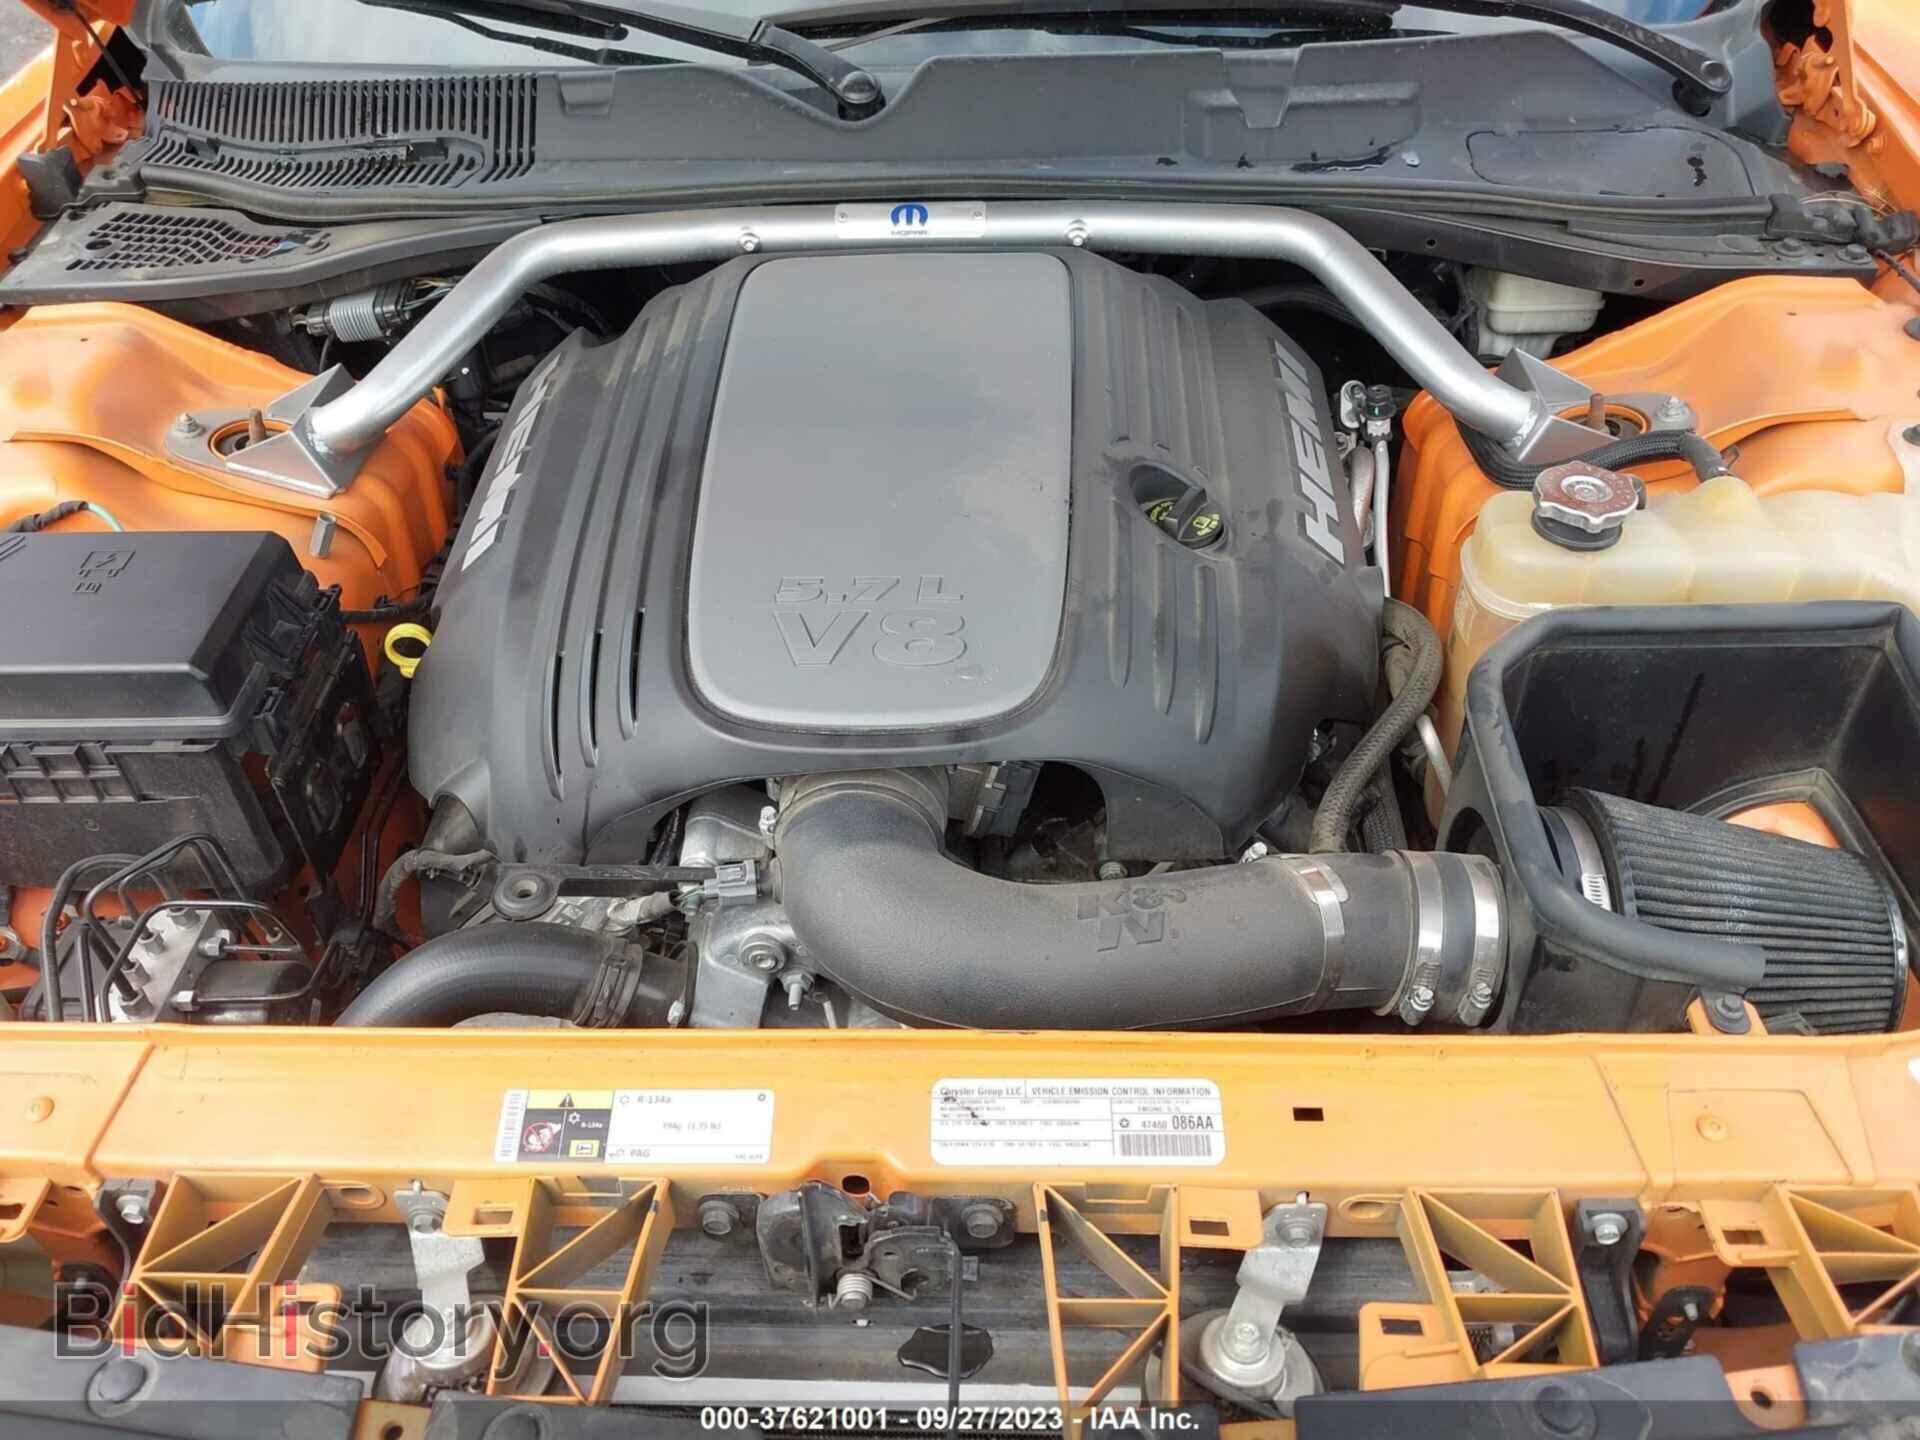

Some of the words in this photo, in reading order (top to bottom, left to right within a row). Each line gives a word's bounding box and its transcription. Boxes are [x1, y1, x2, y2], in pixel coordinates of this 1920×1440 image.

[1273, 339, 1345, 565] HEMI
[771, 608, 968, 668] V8
[978, 1087, 1003, 1097] Group
[1005, 1087, 1022, 1096] LLC
[1032, 1087, 1066, 1096] VEHICLE
[1069, 1087, 1109, 1096] EMISSION
[1112, 1087, 1149, 1096] CONTROL
[1153, 1087, 1211, 1096] INFORMATION
[1172, 1115, 1213, 1130] 086AA
